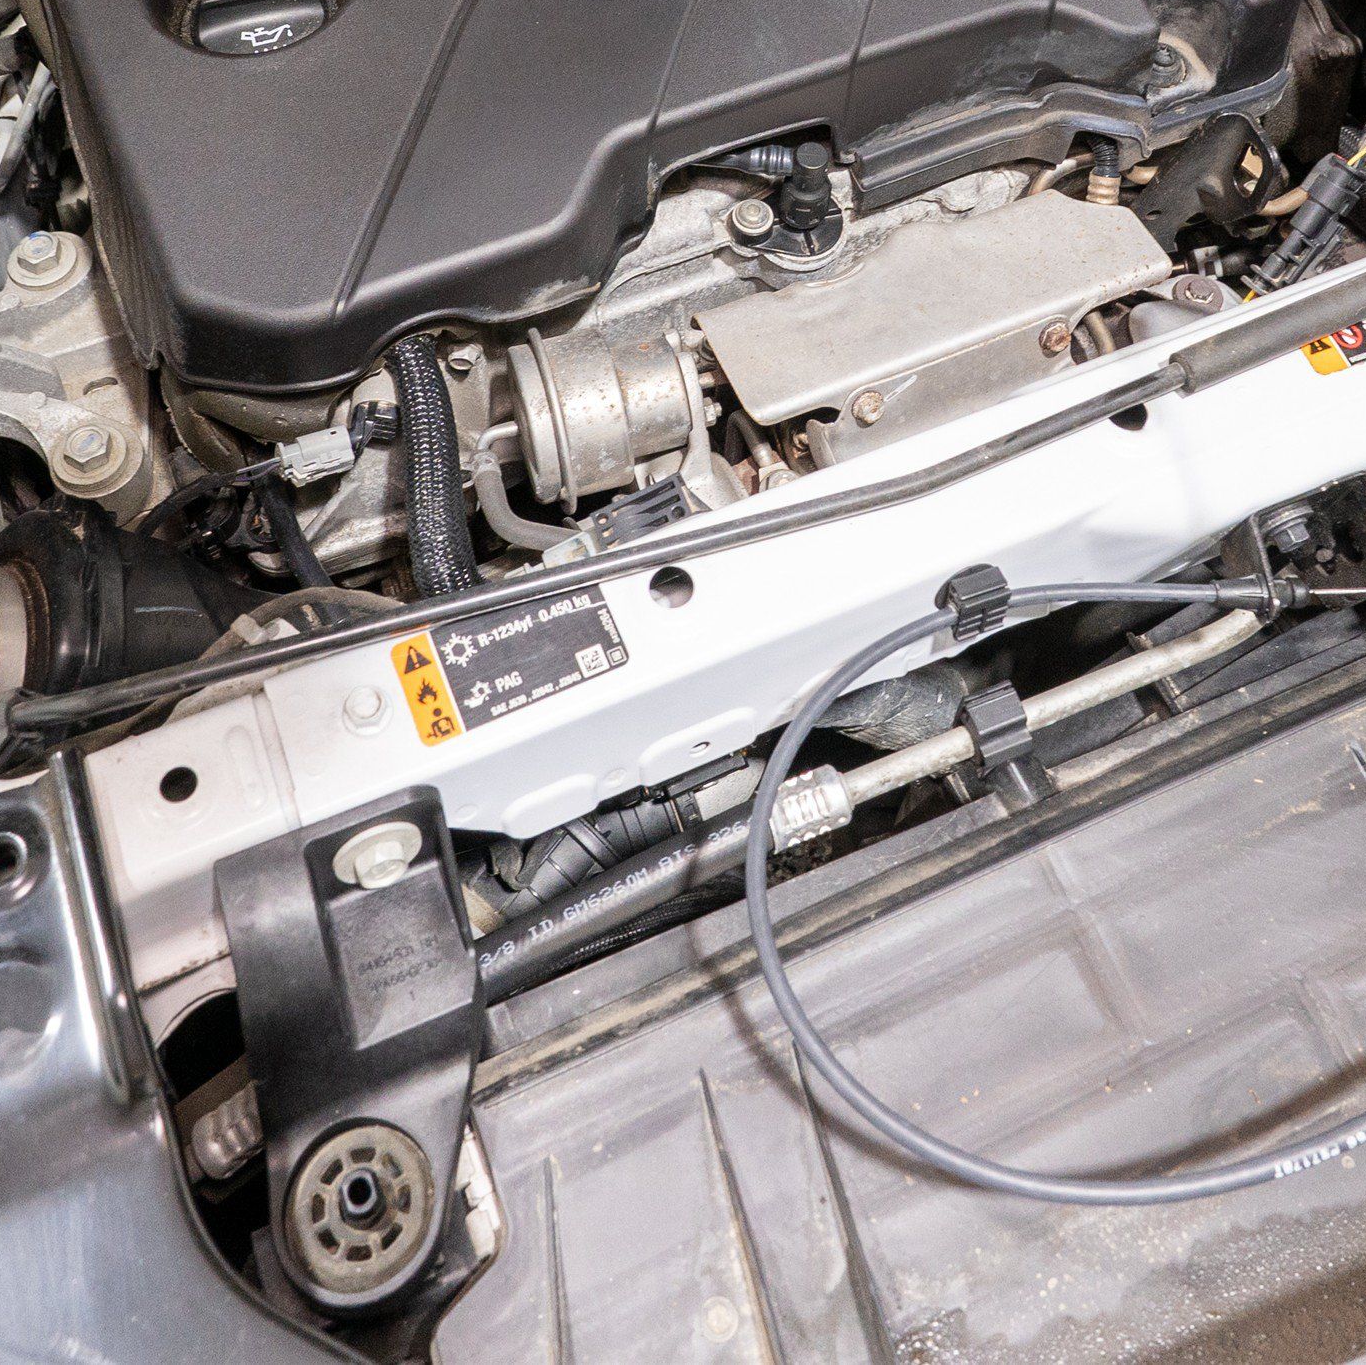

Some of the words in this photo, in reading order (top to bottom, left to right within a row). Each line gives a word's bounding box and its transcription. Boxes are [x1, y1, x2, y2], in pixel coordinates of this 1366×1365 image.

[477, 614, 534, 649] R-1234yf
[537, 599, 574, 623] 0.450
[572, 594, 591, 611] kg
[494, 671, 523, 694] PAG
[479, 940, 515, 969] 3/8
[528, 919, 554, 941] ID
